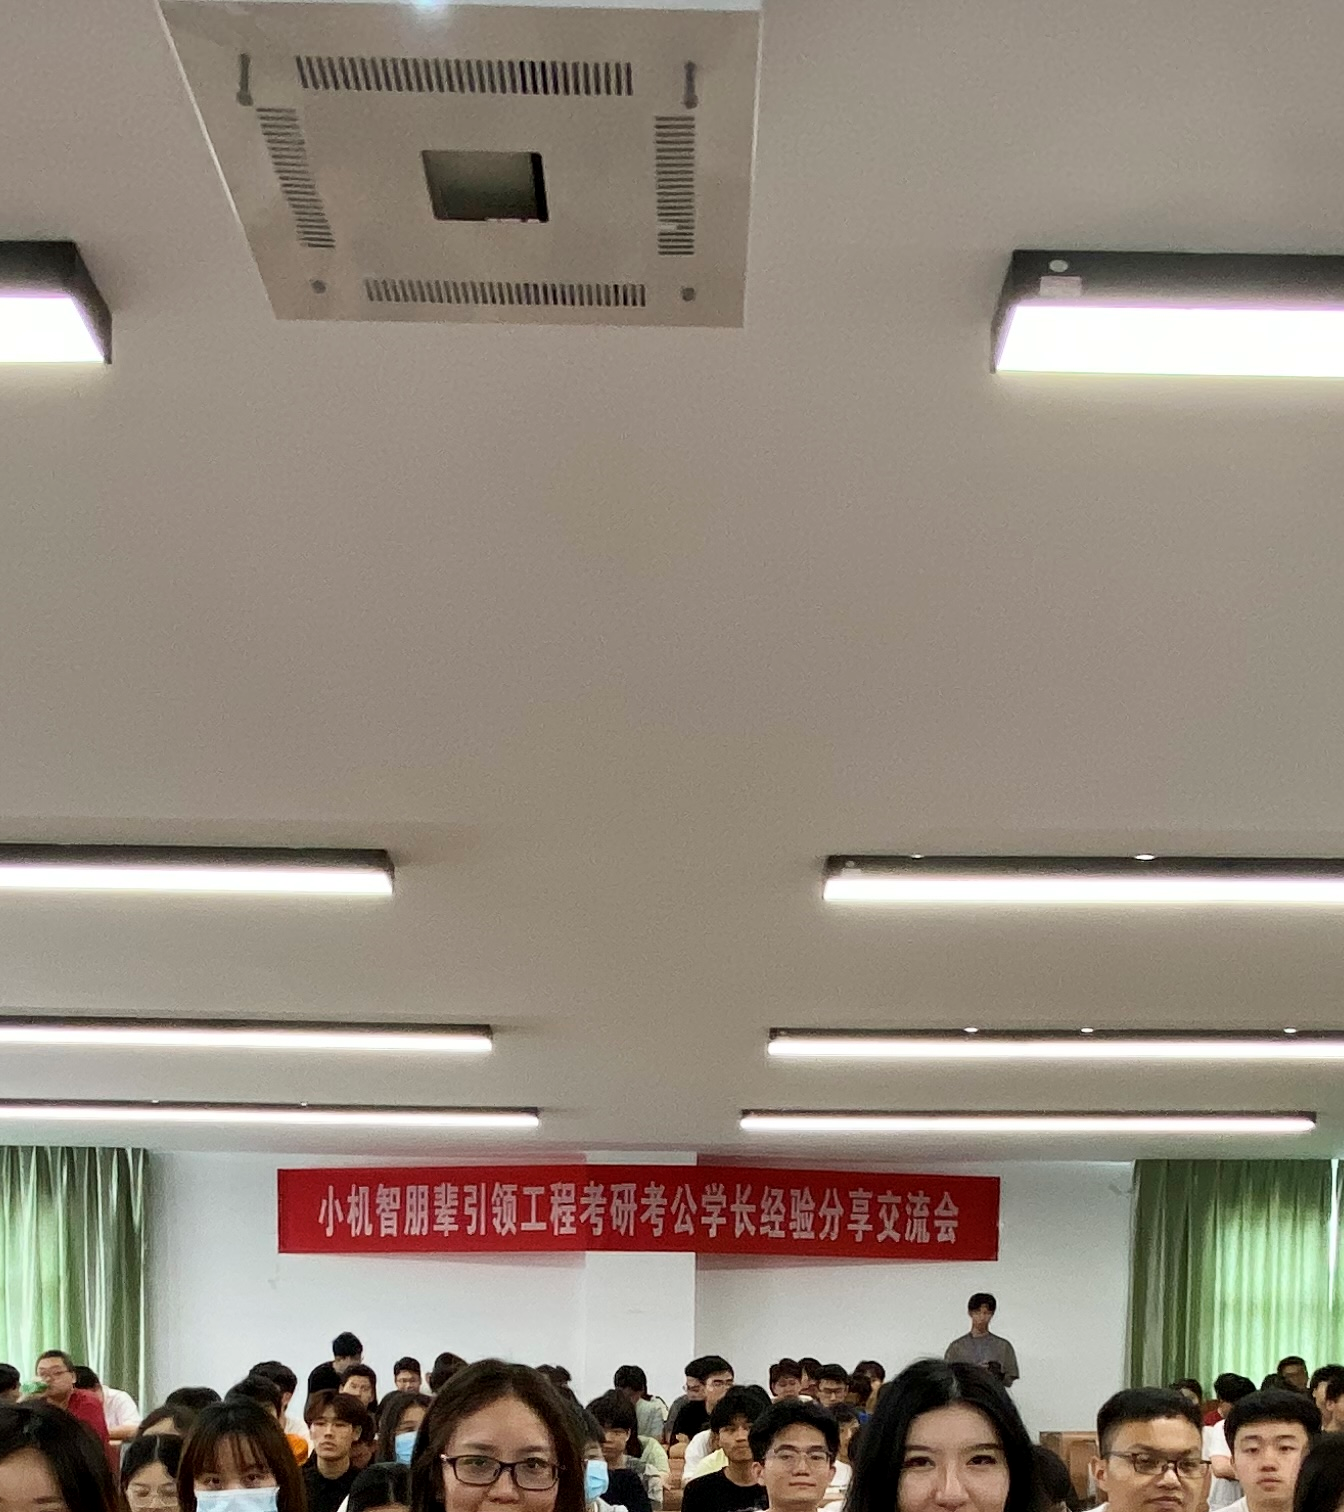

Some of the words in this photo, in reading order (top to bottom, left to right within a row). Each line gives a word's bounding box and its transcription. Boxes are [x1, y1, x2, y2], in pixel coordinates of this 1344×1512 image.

[318, 1181, 959, 1244] 小机智朋辈引领工程考研考公学长经验分享交流会
